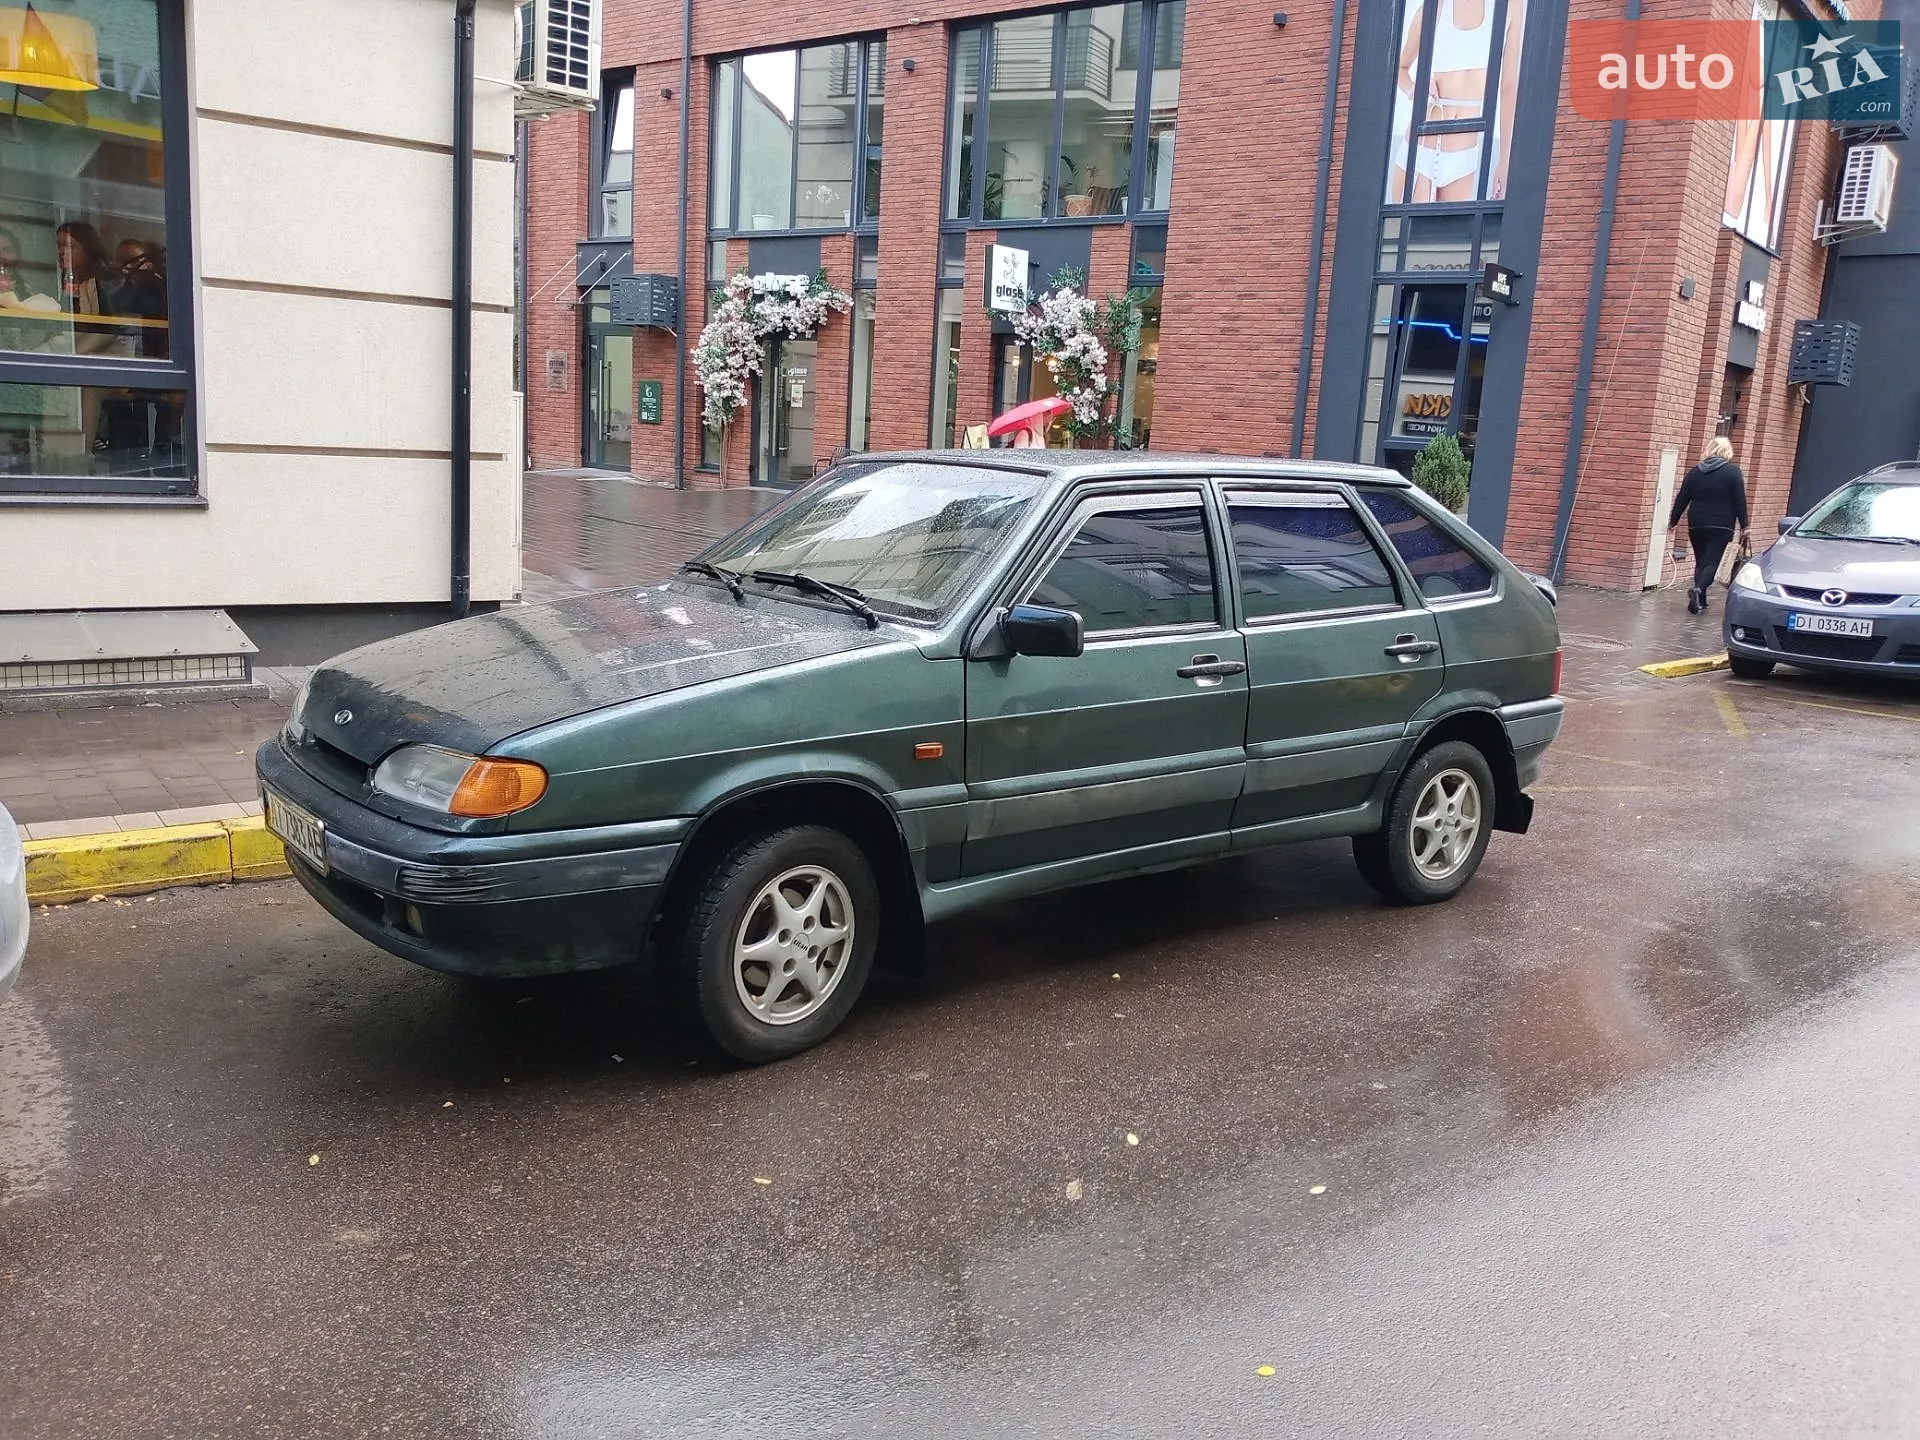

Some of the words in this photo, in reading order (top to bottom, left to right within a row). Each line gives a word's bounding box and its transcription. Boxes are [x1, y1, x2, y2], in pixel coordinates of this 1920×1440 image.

[1796, 616, 1812, 629] DI
[1817, 618, 1847, 632] 0338
[1850, 621, 1870, 634] AH
